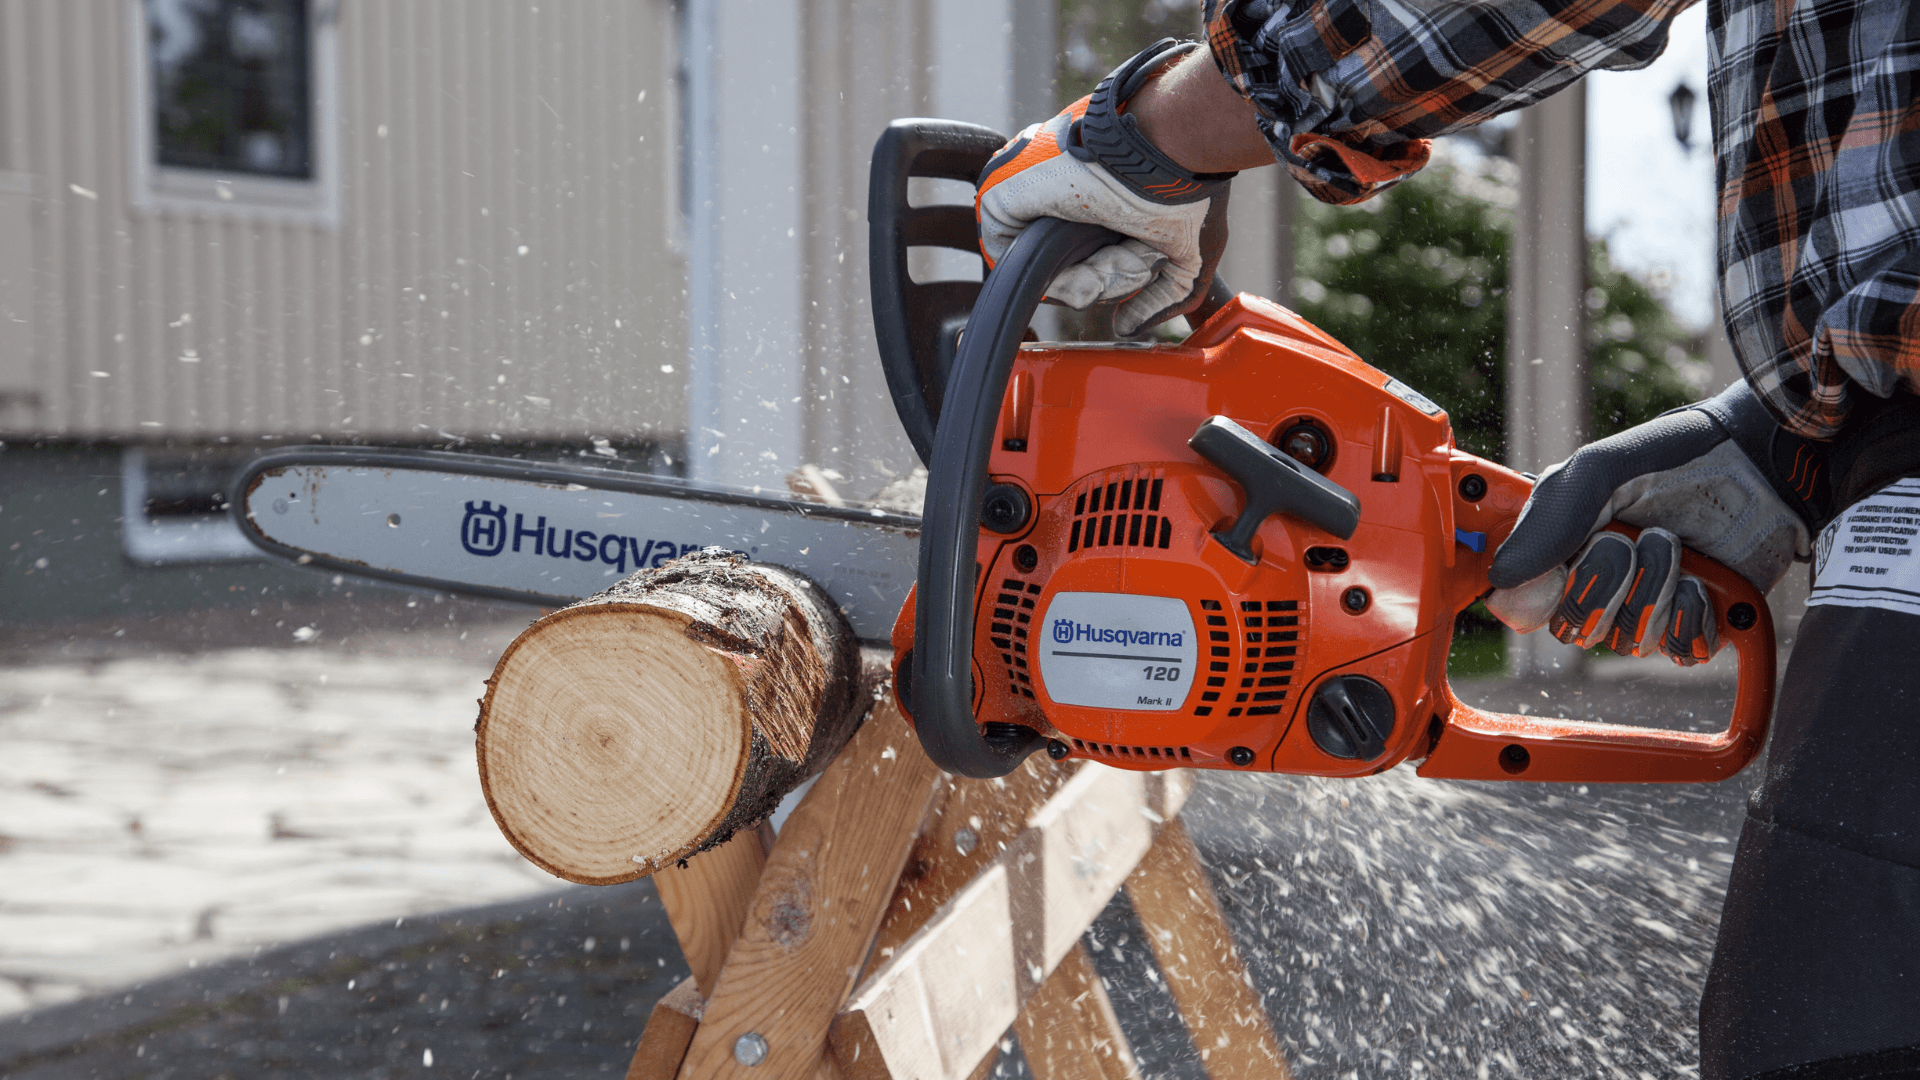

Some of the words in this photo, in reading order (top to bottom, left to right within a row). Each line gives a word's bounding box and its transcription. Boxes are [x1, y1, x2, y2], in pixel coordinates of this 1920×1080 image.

[1864, 505, 1893, 514] PROTECTIVE
[1851, 515, 1880, 523] ACCORDANCE
[1892, 516, 1914, 525] ASTM
[1874, 526, 1918, 536] SPECIFICATION
[512, 513, 751, 574] Husqvar
[1872, 536, 1908, 546] PROTECTION
[1878, 547, 1897, 555] USER
[1864, 566, 1874, 574] OR
[1076, 623, 1182, 647] Husqvarna
[1143, 666, 1180, 682] 120
[1137, 696, 1162, 706] Mark
